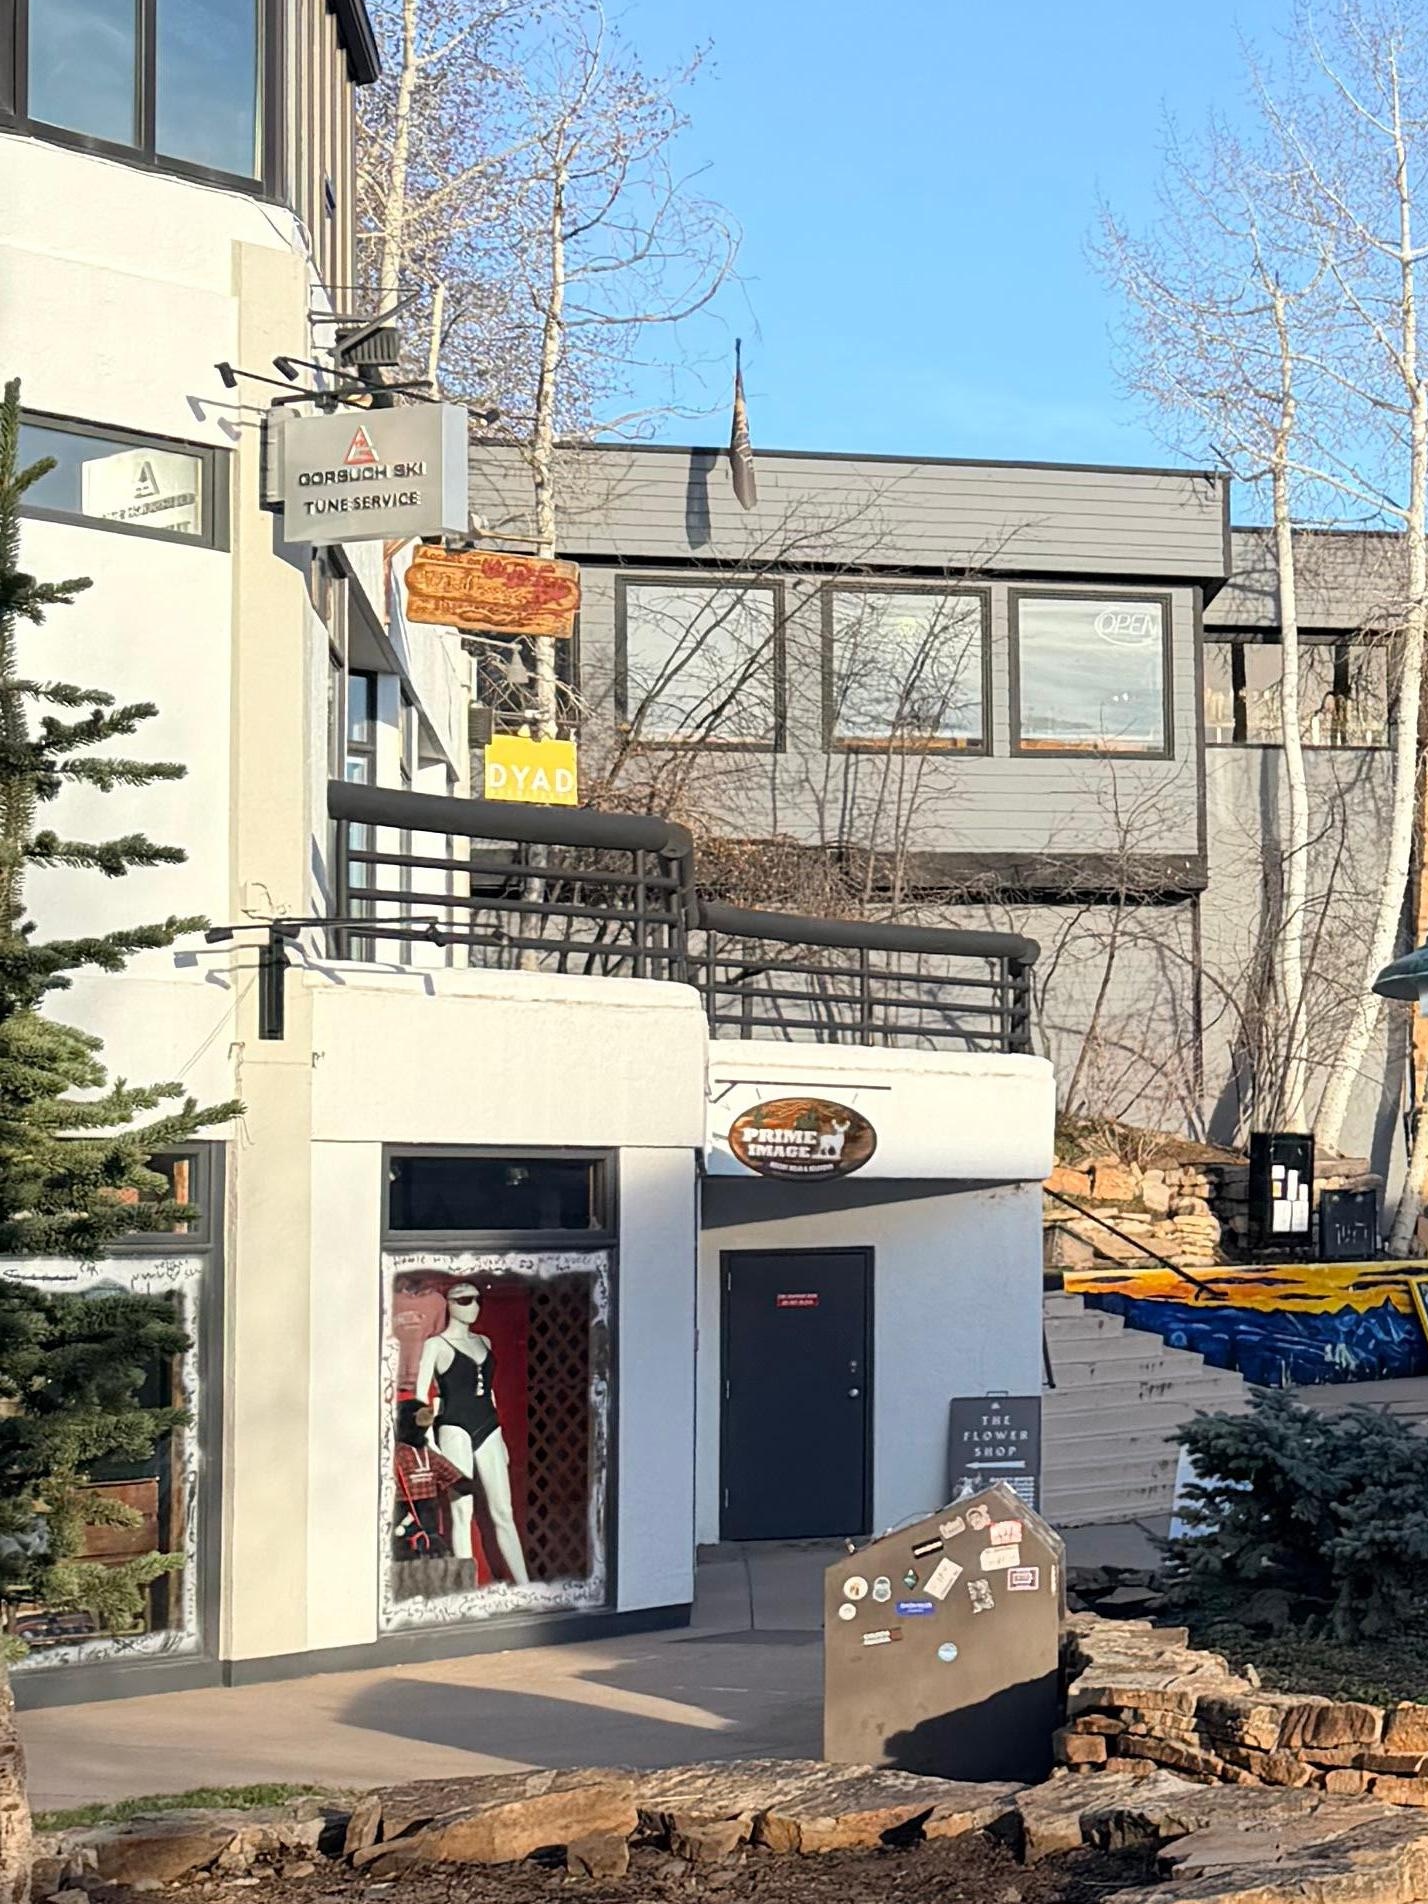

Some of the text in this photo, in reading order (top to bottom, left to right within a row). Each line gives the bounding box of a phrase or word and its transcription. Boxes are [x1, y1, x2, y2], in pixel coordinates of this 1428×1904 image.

[298, 461, 426, 487] GORSUCH SKI
[304, 491, 420, 515] TUNE SERVICE
[488, 762, 574, 793] DYAD
[741, 1127, 819, 1145] PRIME
[747, 1143, 812, 1159] IMAGE
[981, 1415, 1011, 1426] THE
[962, 1430, 1029, 1442] FLOWER
[974, 1445, 1017, 1457] SHOP
